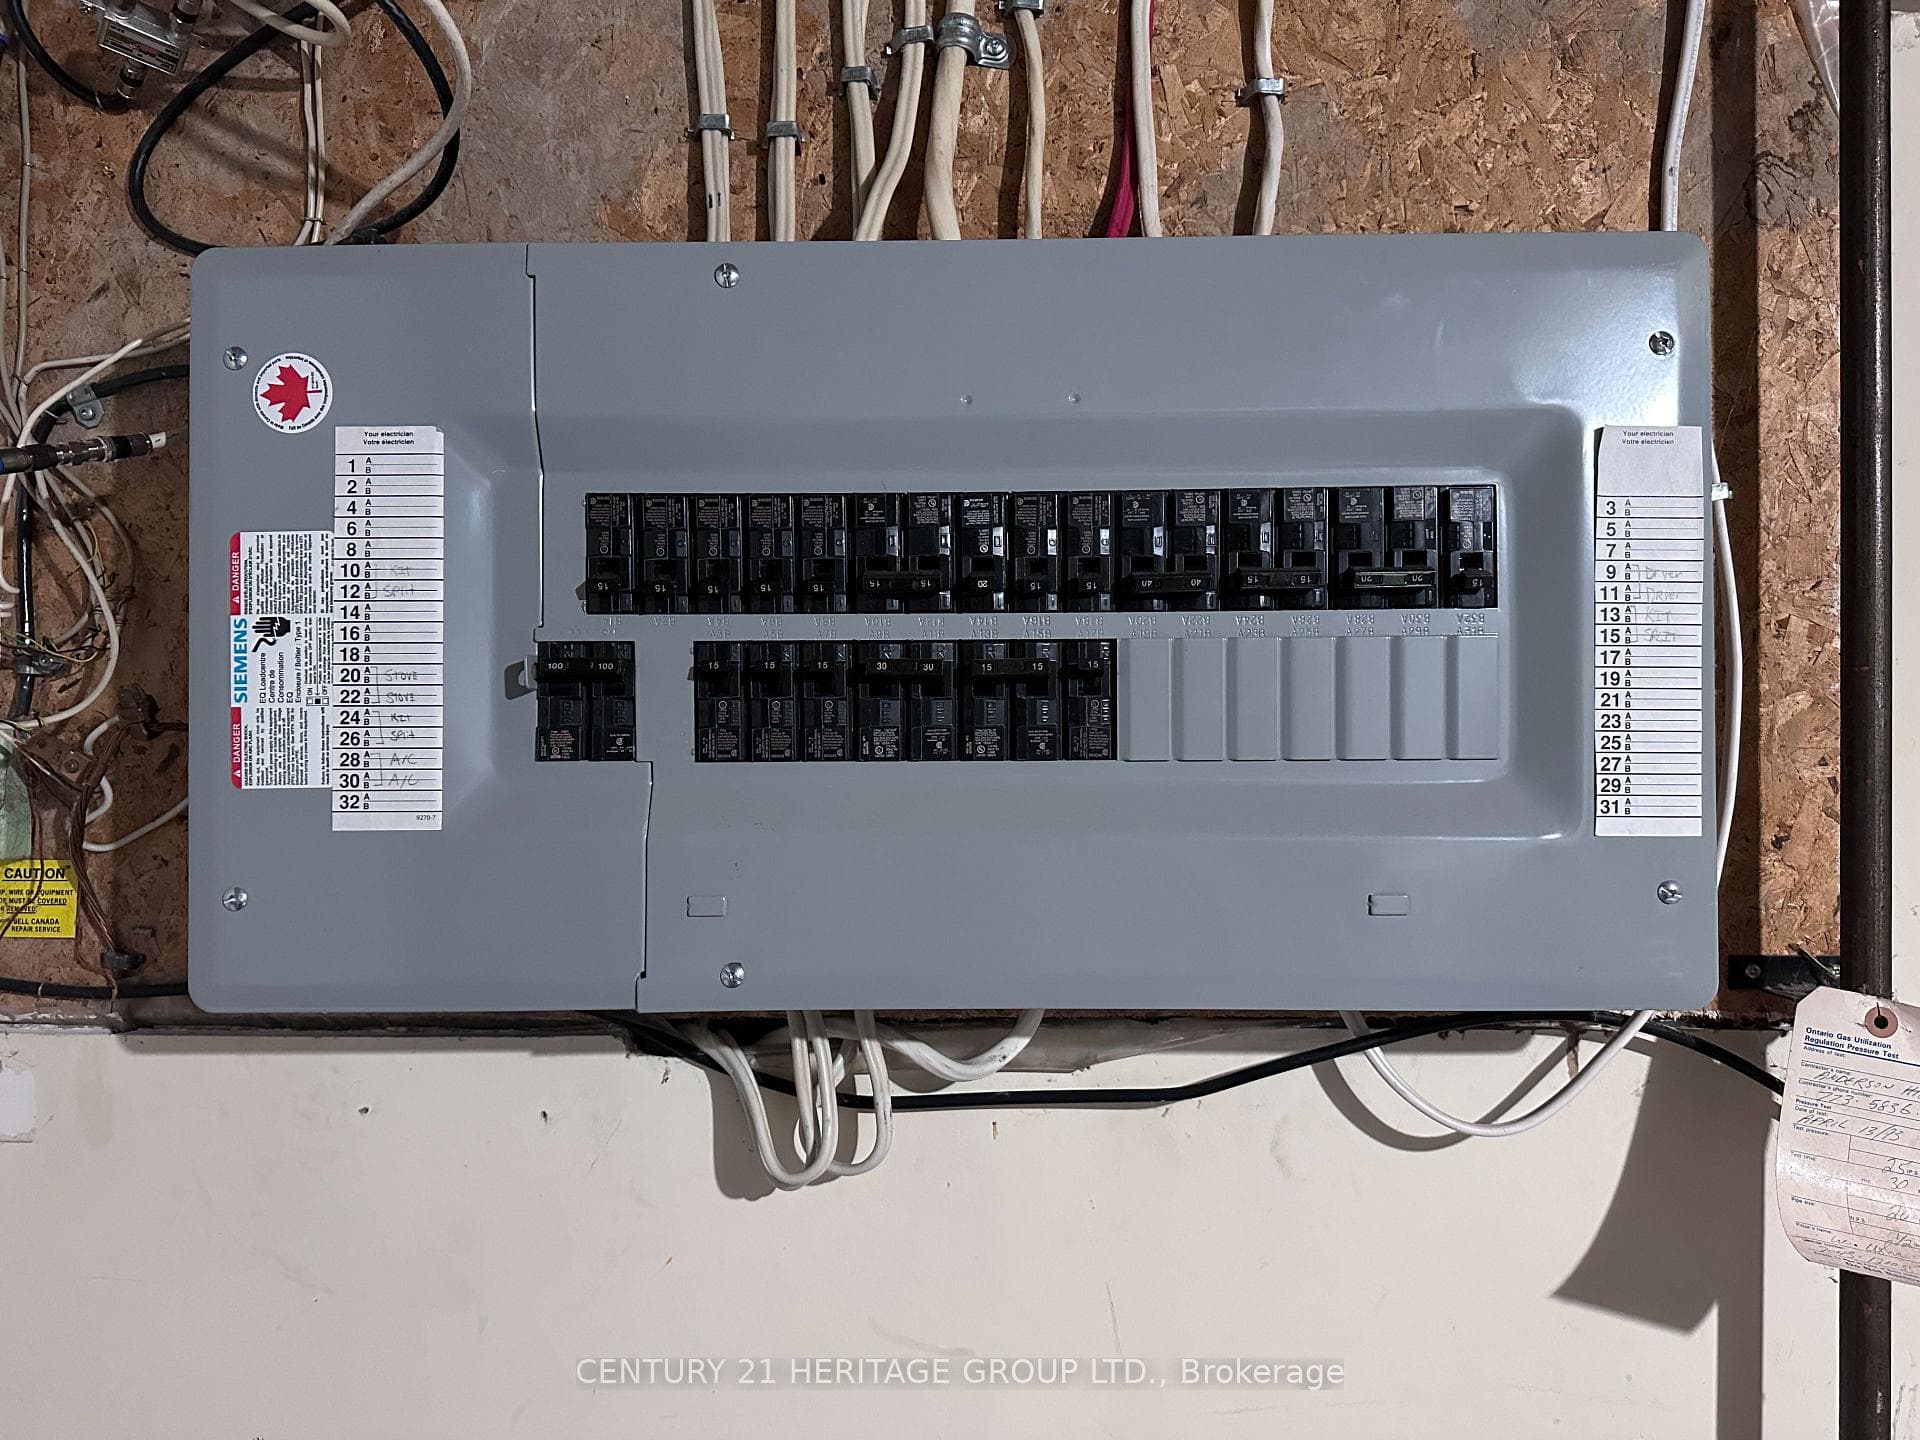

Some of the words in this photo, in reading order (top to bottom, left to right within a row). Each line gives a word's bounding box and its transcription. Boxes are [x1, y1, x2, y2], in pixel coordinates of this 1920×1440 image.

[348, 459, 354, 472] 1
[347, 480, 356, 493] 2
[347, 501, 356, 514] 4
[1607, 501, 1616, 515] 3
[347, 522, 356, 535] 6
[1607, 522, 1616, 536] 5
[347, 543, 356, 556] 8
[1606, 544, 1616, 557] 7
[231, 552, 240, 591] DANGER
[341, 564, 360, 577] 10
[1607, 565, 1616, 579] 9
[869, 580, 880, 588] 15
[921, 580, 931, 588] 15
[977, 580, 988, 588] 20
[1030, 582, 1041, 590] 15
[1086, 581, 1097, 589] 15
[1300, 575, 1312, 584] 15
[1472, 578, 1483, 587] 15
[341, 584, 360, 598] 12
[655, 584, 666, 592] 15
[707, 585, 719, 593] 15
[1600, 586, 1617, 600] 11
[341, 606, 360, 619] 14
[1601, 608, 1620, 621] 13
[295, 627, 303, 642] Type
[340, 626, 359, 640] 16
[1601, 629, 1620, 643] 15
[234, 618, 248, 703] SIEMENS
[340, 647, 359, 661] 18
[1601, 651, 1620, 664] 17
[547, 662, 564, 670] 100
[598, 662, 614, 670] 100
[708, 661, 719, 669] 15
[764, 661, 775, 669] 15
[817, 661, 828, 669] 15
[876, 662, 887, 671] 30
[923, 663, 934, 671] 30
[981, 663, 992, 671] 15
[1032, 662, 1043, 671] 15
[1087, 660, 1099, 668] 15
[259, 653, 267, 690] Loadcentre
[268, 670, 275, 679] de
[341, 668, 360, 682] 20
[1601, 672, 1620, 686] 19
[259, 692, 267, 703] EQ
[286, 692, 293, 703] EQ
[340, 690, 360, 703] 22
[1601, 693, 1618, 706] 21
[340, 711, 360, 724] 24
[1601, 714, 1621, 728] 23
[232, 723, 241, 763] DANGER
[340, 732, 360, 746] 26
[1601, 736, 1621, 750] 25
[340, 753, 360, 767] 28
[390, 752, 417, 766] A/C
[1601, 757, 1621, 771] 27
[340, 774, 359, 788] 30
[1601, 778, 1621, 792] 29
[340, 795, 359, 809] 32
[1601, 800, 1618, 814] 31
[4, 868, 65, 879] CAUTON
[1806, 1026, 1834, 1039] Ontario
[1836, 1033, 1851, 1042] Gas
[1854, 1036, 1892, 1050] Utilization
[1804, 1035, 1845, 1049] Regulation
[1847, 1043, 1880, 1056] Pressure
[1883, 1050, 1900, 1060] Test
[1795, 1098, 1819, 1108] Pressure
